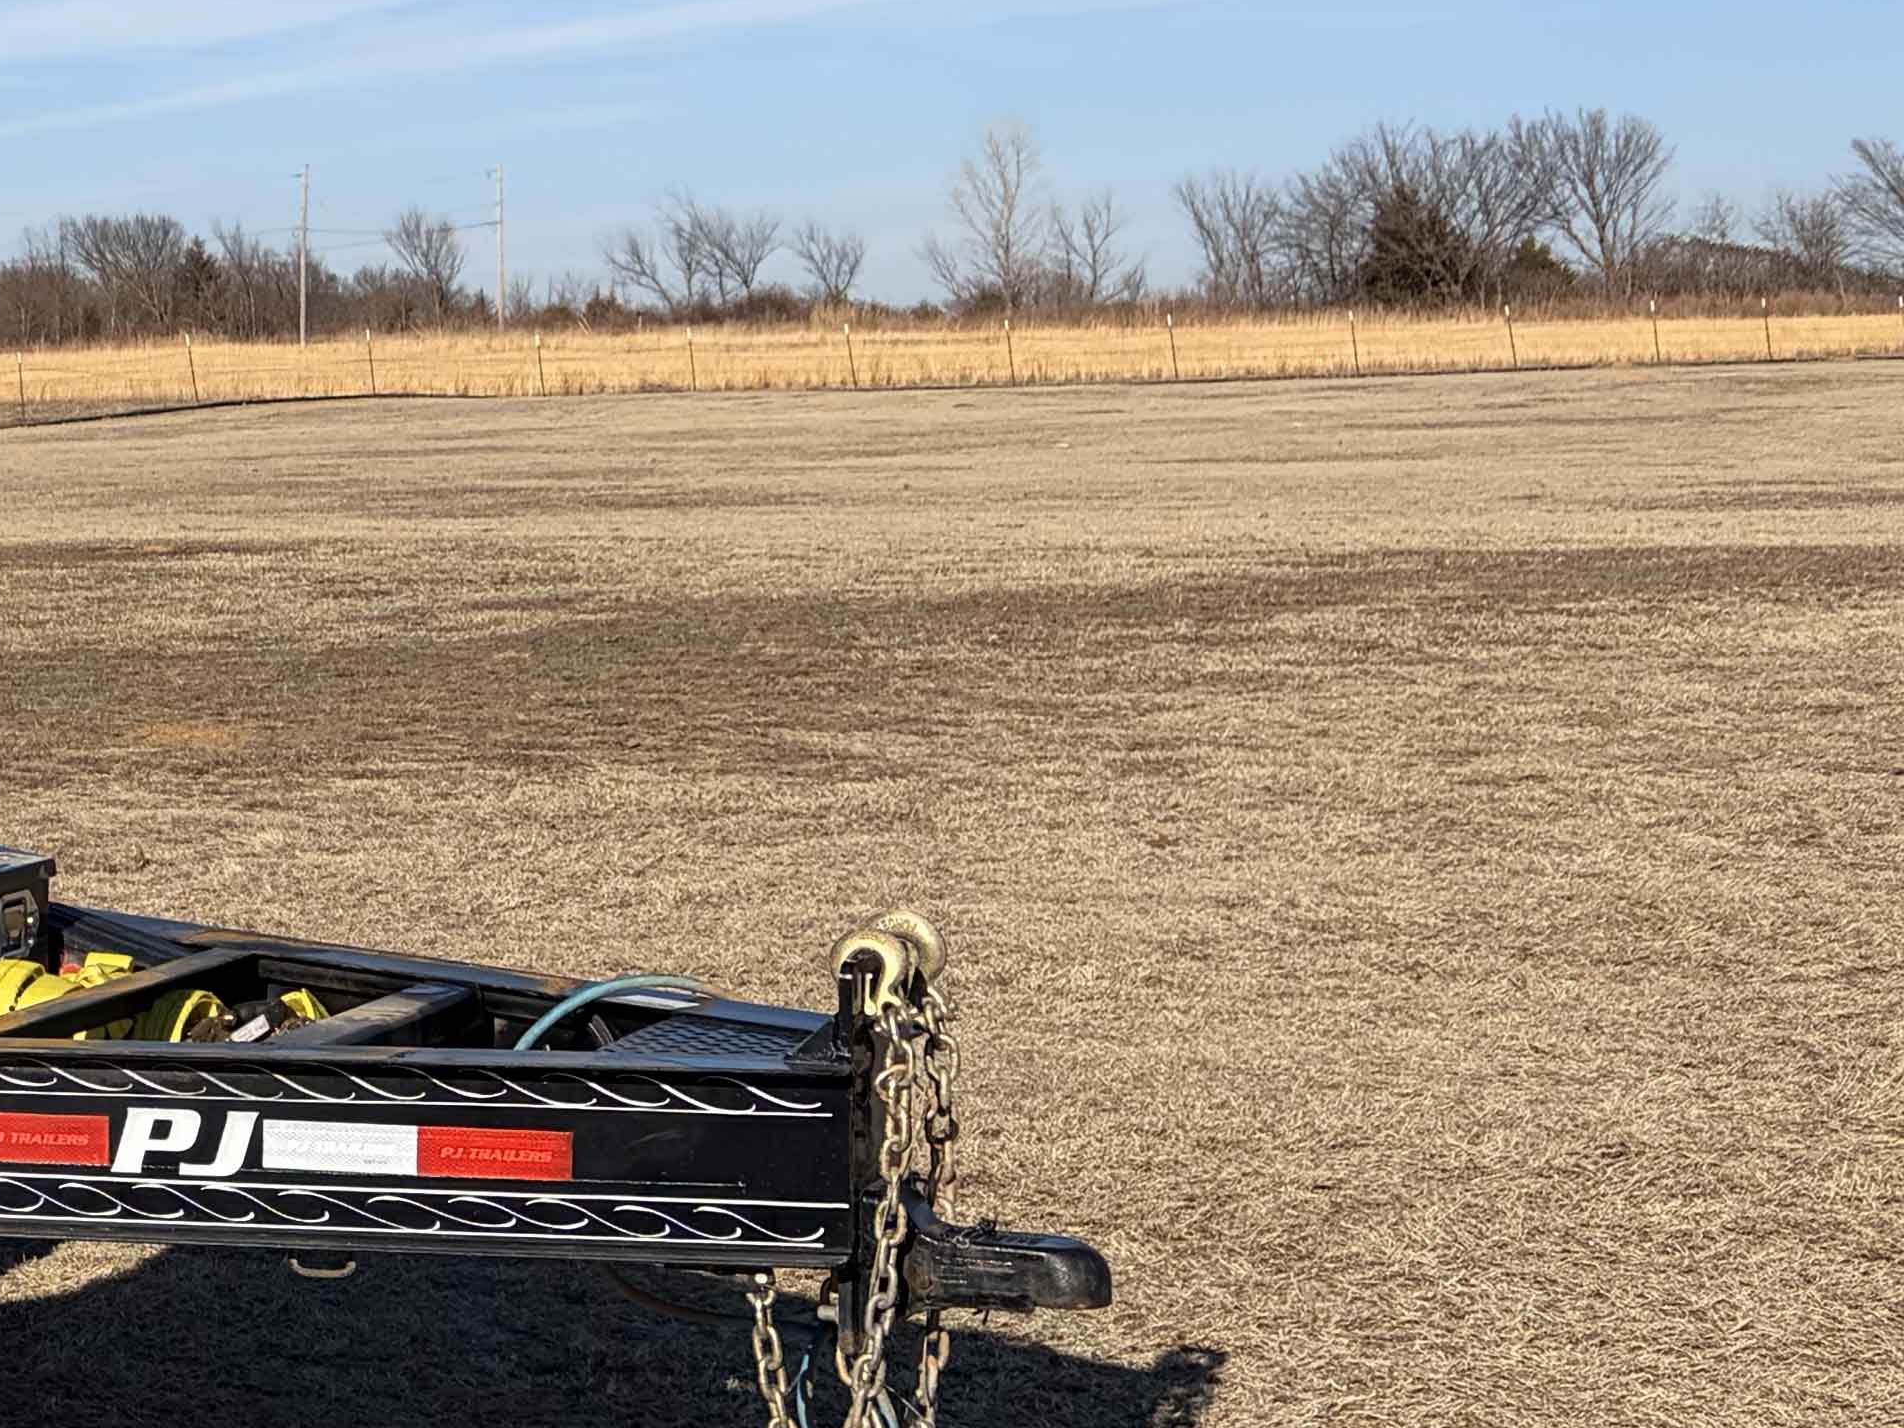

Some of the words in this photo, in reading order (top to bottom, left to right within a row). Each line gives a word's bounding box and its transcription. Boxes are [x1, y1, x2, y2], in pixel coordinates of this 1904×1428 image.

[10, 1132, 90, 1146] TRAILERS
[110, 1106, 262, 1177] PJ
[468, 1147, 553, 1163] TRAILERS
